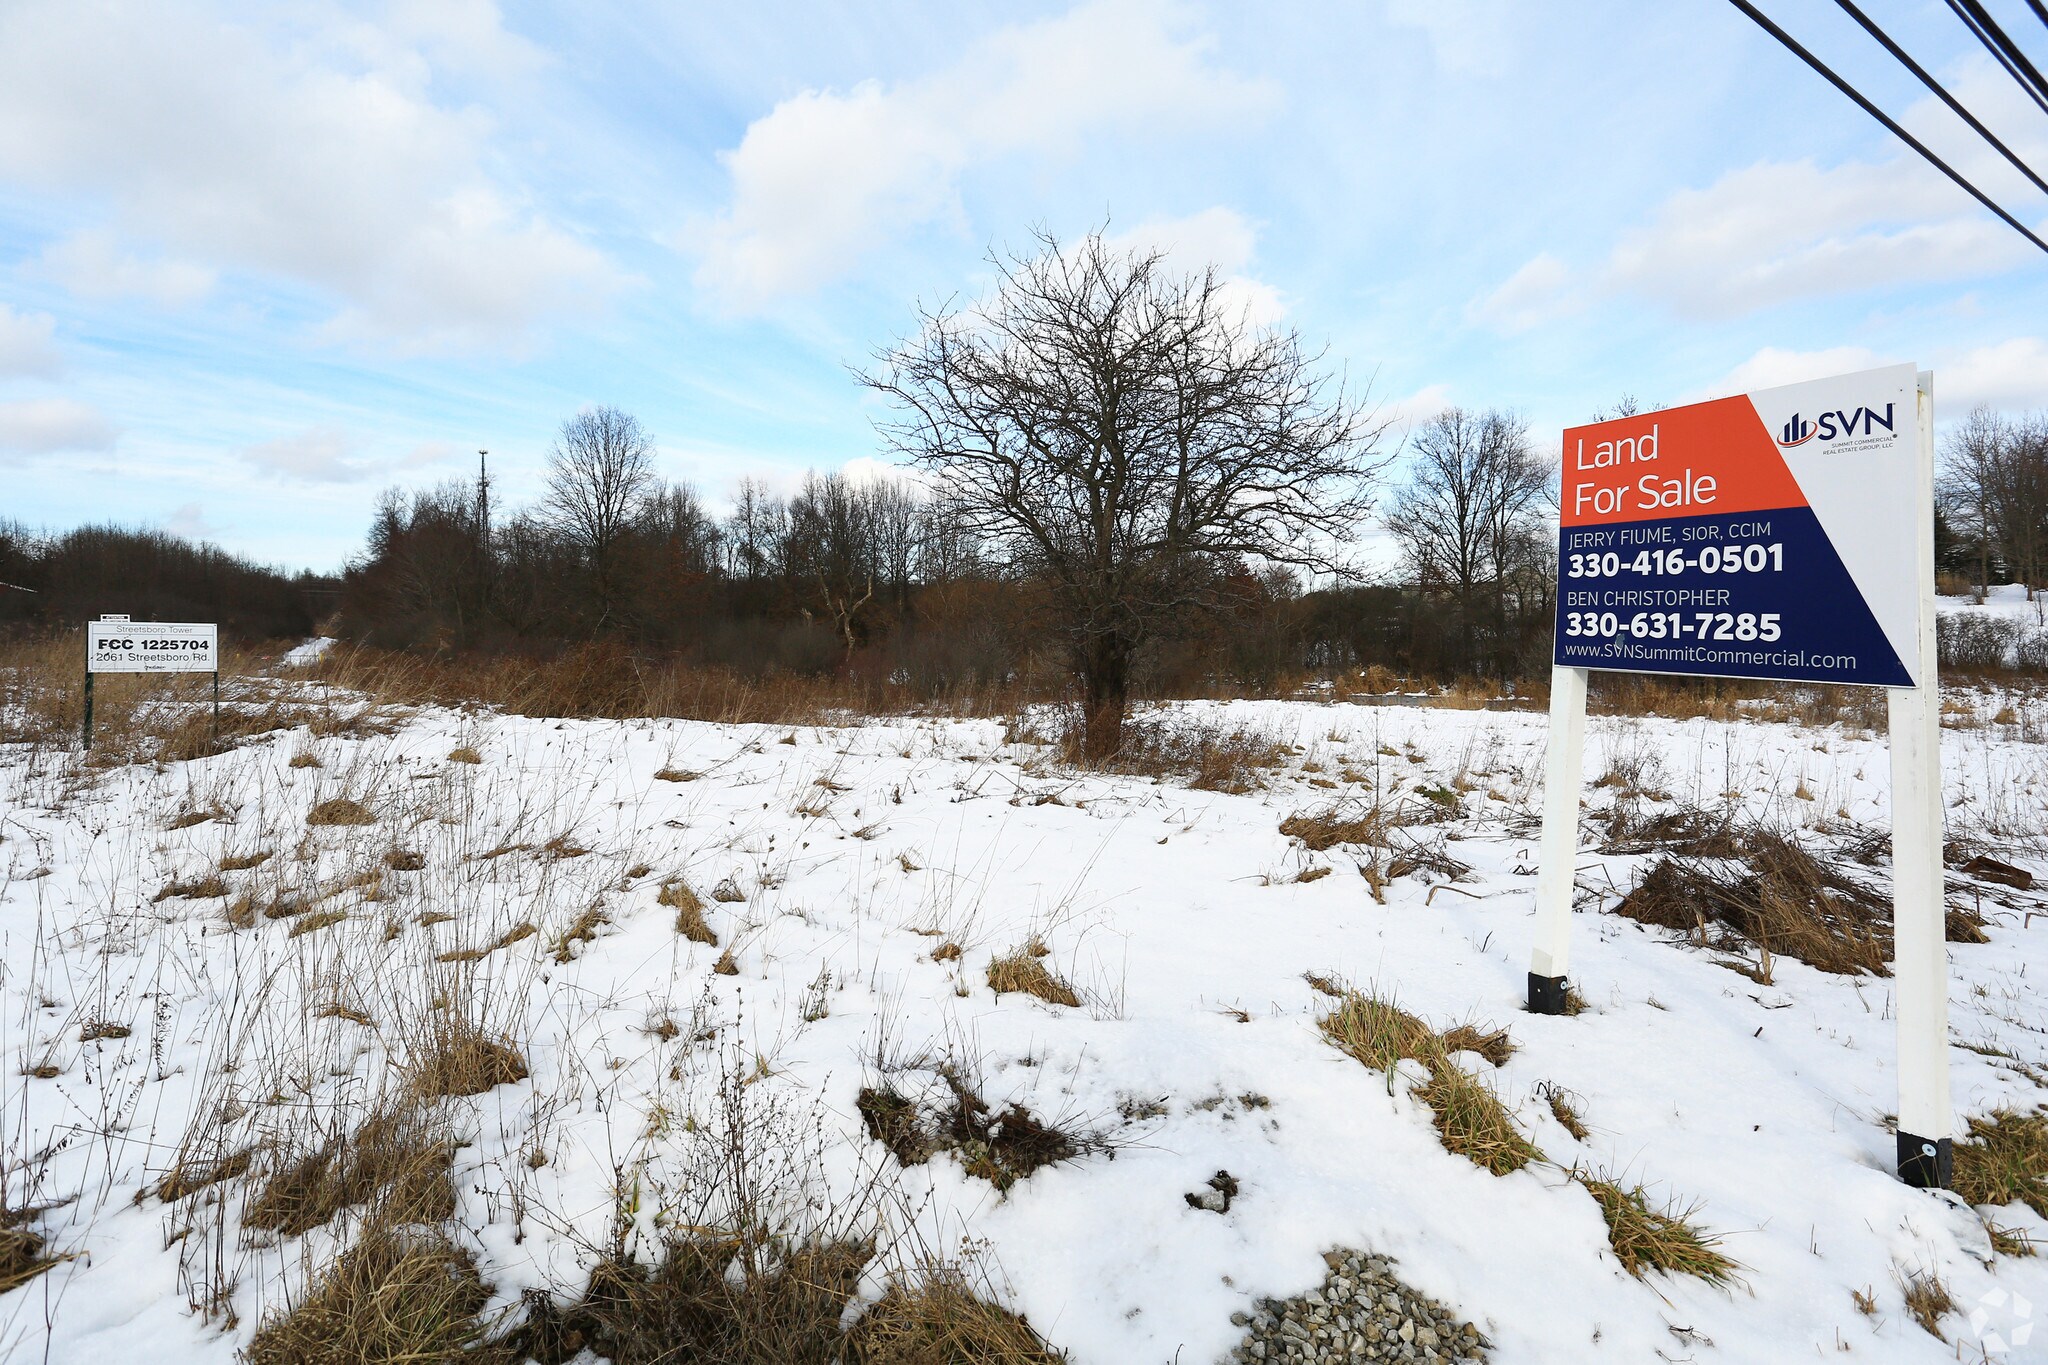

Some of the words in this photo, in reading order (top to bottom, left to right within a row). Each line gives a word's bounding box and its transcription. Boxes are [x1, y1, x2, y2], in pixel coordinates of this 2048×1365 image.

[1818, 403, 1893, 440] SVN
[1577, 424, 1659, 471] Land
[1838, 446, 1857, 454] ESTATE
[1854, 437, 1893, 446] COMMERCIAL
[1575, 482, 1630, 516] For
[1637, 469, 1717, 510] Sale
[1568, 531, 1615, 551] JERRY
[1620, 526, 1677, 545] FIUME,
[1682, 524, 1724, 542] SIOR,
[1728, 522, 1772, 539] CCIM
[1568, 543, 1783, 578] 330-416-0501
[1567, 592, 1599, 606] BEN
[1604, 589, 1730, 607] CHRISTOPHER
[116, 625, 166, 633] Streetsboro
[169, 626, 193, 634] Tower
[1565, 612, 1782, 642] 330-631-7285
[96, 652, 123, 662] 2061
[128, 652, 189, 662] Streetsboro
[193, 653, 210, 662] Rd.
[98, 639, 134, 650] FCC
[141, 640, 209, 650] 1225704
[1565, 643, 1857, 670] www.SVNSummitCommercial.com
